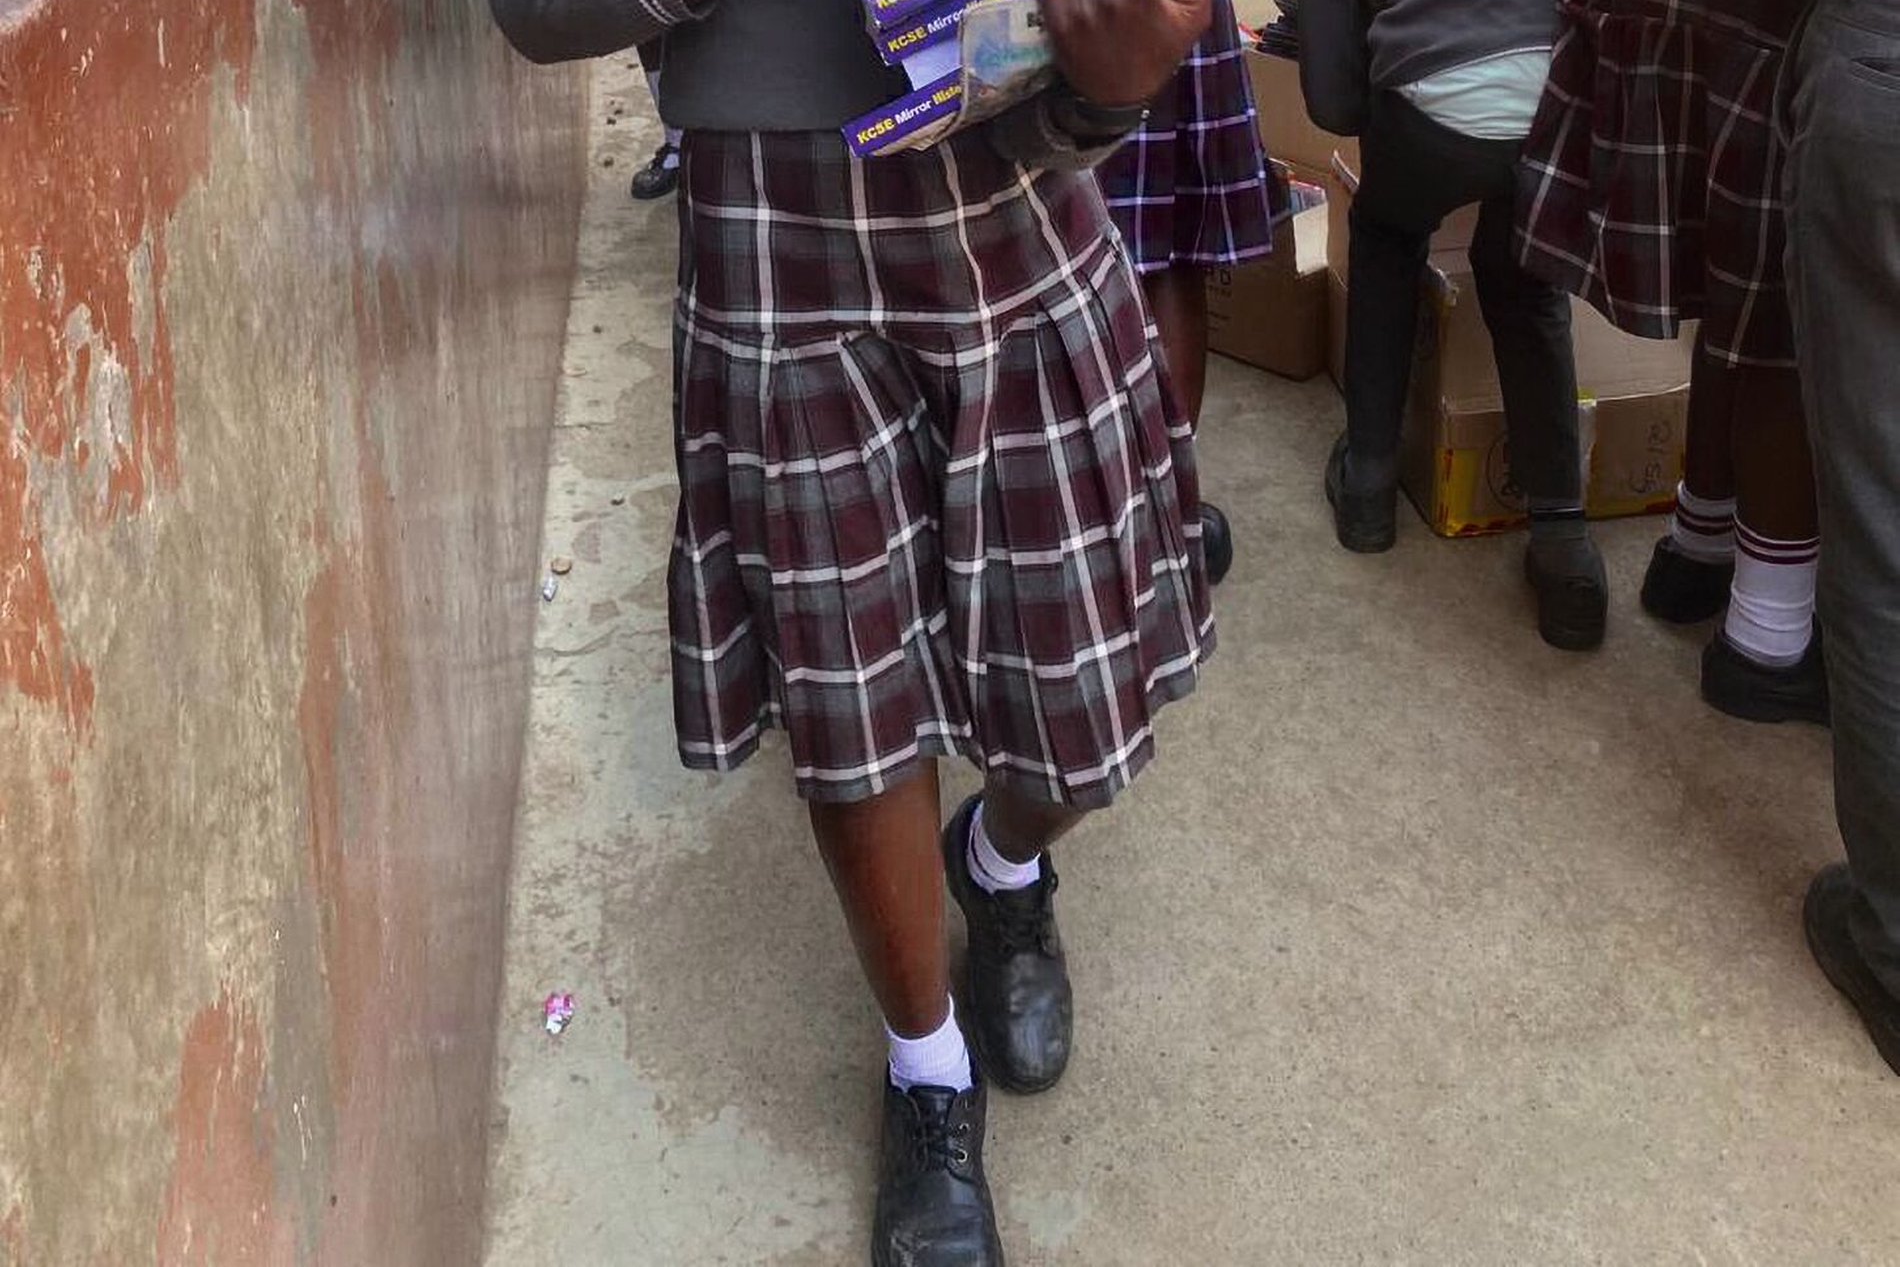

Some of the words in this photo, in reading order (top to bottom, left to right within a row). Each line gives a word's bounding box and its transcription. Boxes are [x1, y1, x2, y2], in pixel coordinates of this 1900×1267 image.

[887, 25, 928, 53] KCSE
[856, 118, 896, 145] KCSE
[894, 100, 932, 125] Mirror
